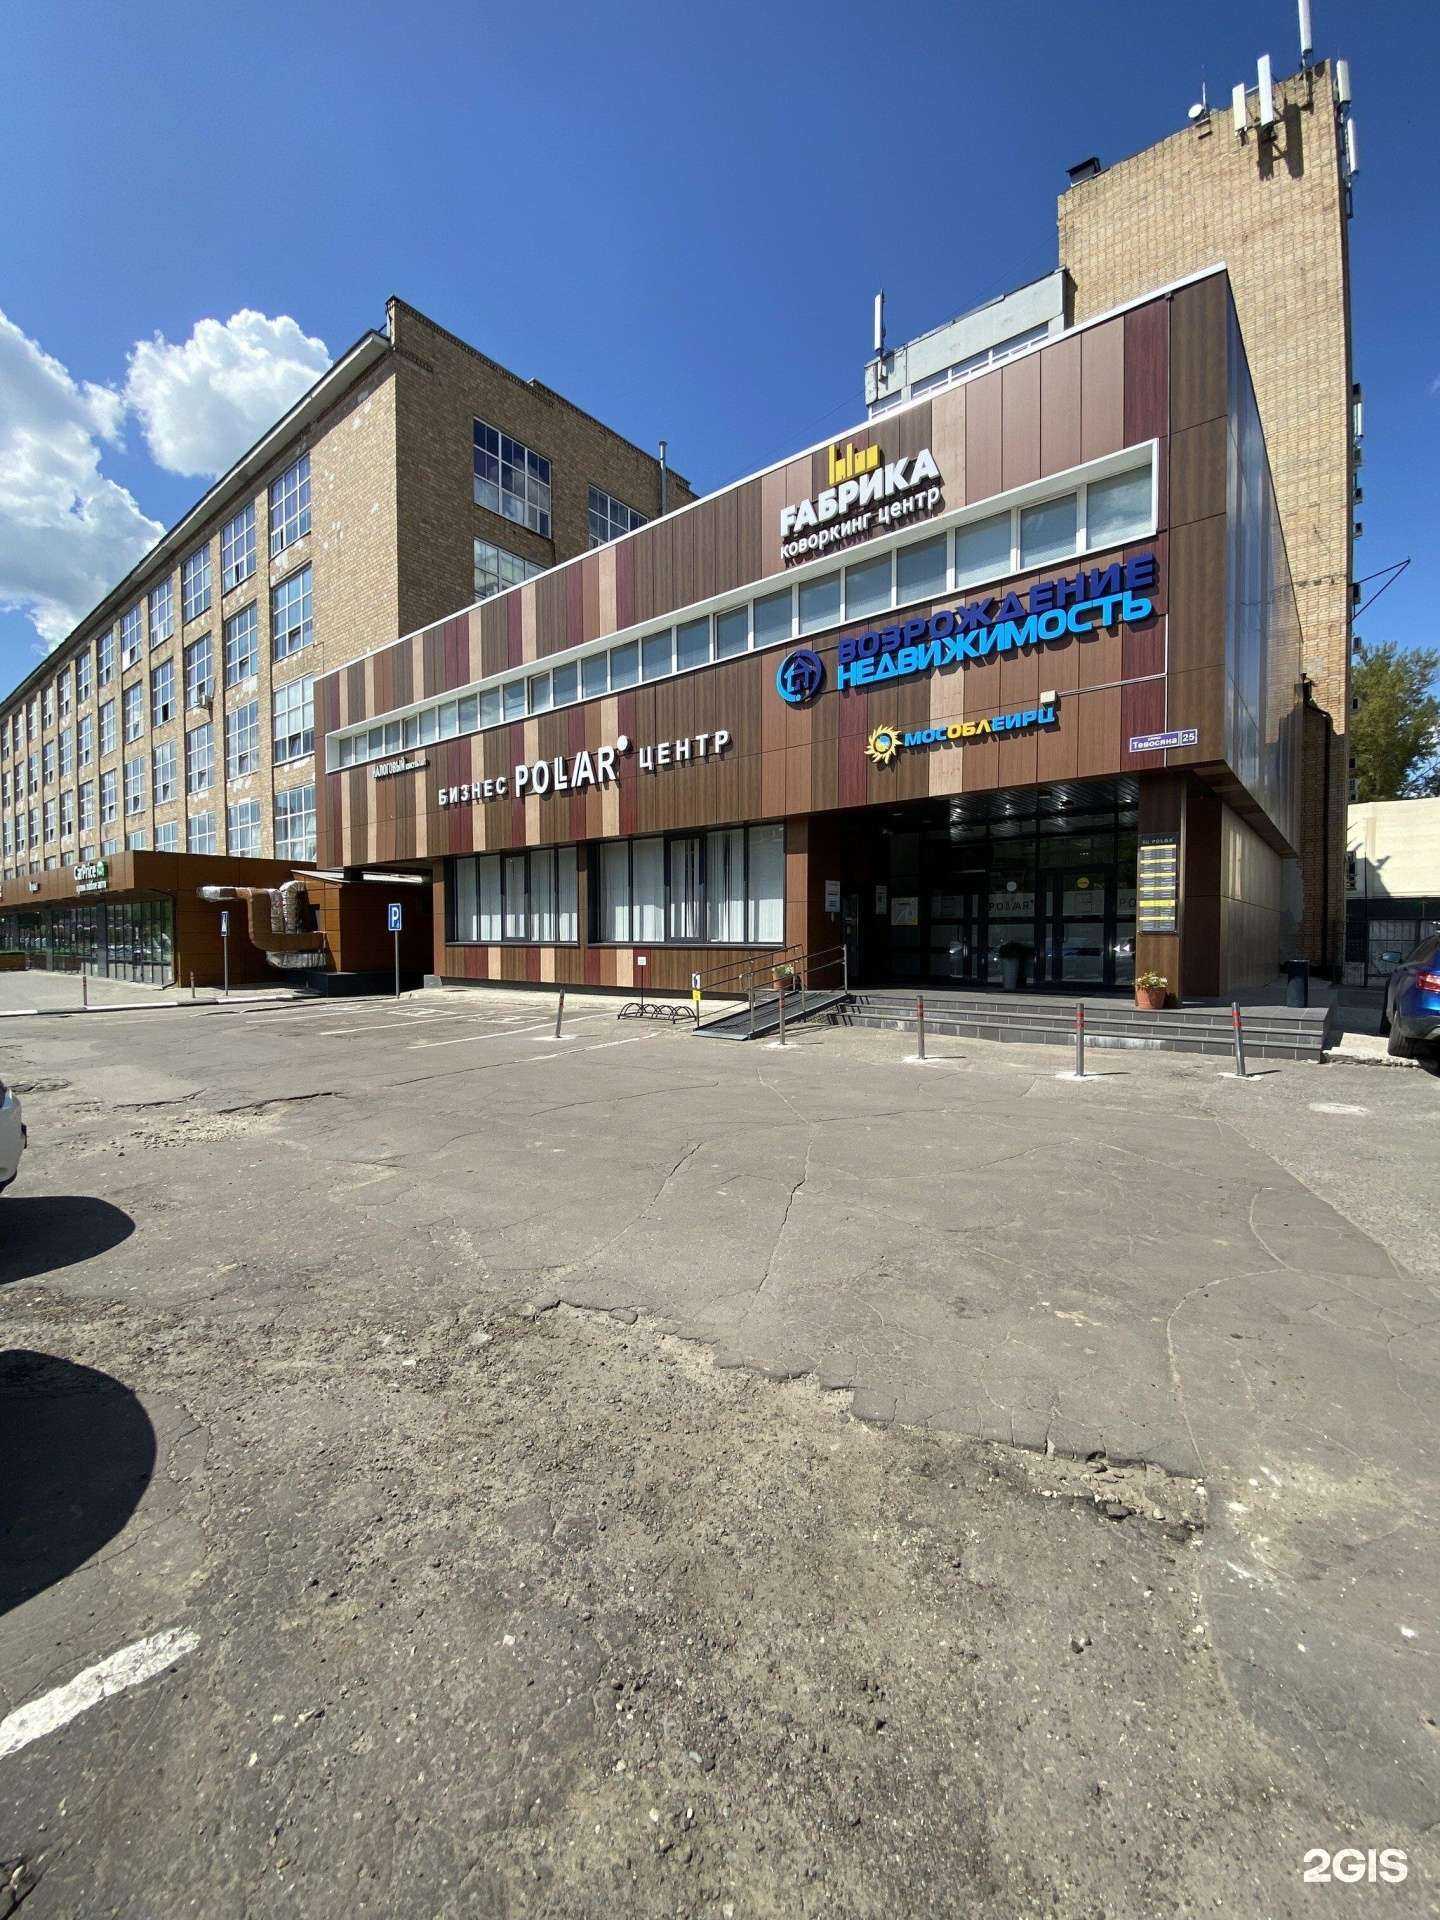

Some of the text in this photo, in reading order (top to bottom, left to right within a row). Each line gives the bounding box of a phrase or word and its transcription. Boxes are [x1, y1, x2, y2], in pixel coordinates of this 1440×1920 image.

[780, 486, 940, 559] коворкинг центр
[837, 591, 1152, 690] НЕДВИЖИМОСТЬ
[838, 553, 1156, 663] ВОЗРОЖДЕНИЕ
[904, 707, 1056, 747] МОСОБЛЕИРЦ
[1132, 737, 1178, 749] Тевосяна
[1182, 733, 1195, 742] 25
[438, 730, 731, 806] БИЗНЕС POLAR ЦЕНТР
